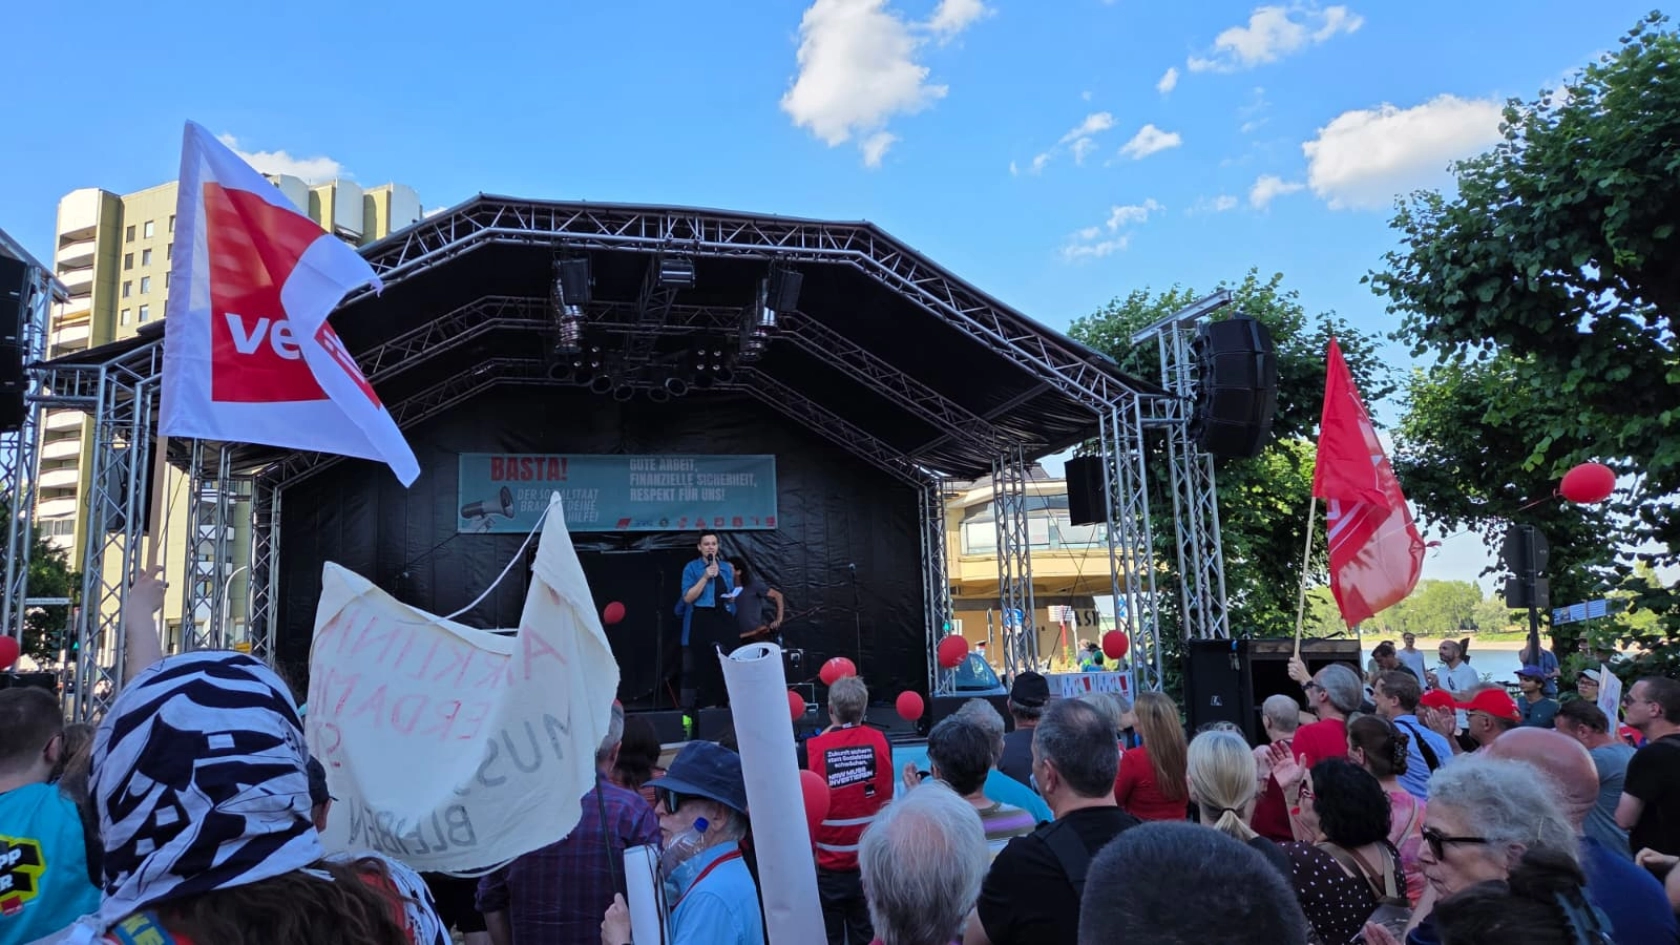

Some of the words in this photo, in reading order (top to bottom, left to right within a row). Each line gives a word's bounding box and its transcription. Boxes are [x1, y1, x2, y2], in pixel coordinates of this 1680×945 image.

[490, 456, 567, 481] BASTA!
[630, 458, 656, 471] GUTE
[658, 458, 698, 472] ARBEIT,
[630, 473, 694, 486] FINANZIELLE
[517, 488, 537, 501] DER
[630, 488, 674, 501] RESPEKT
[679, 485, 698, 501] FÜR
[702, 488, 725, 501] UNS!
